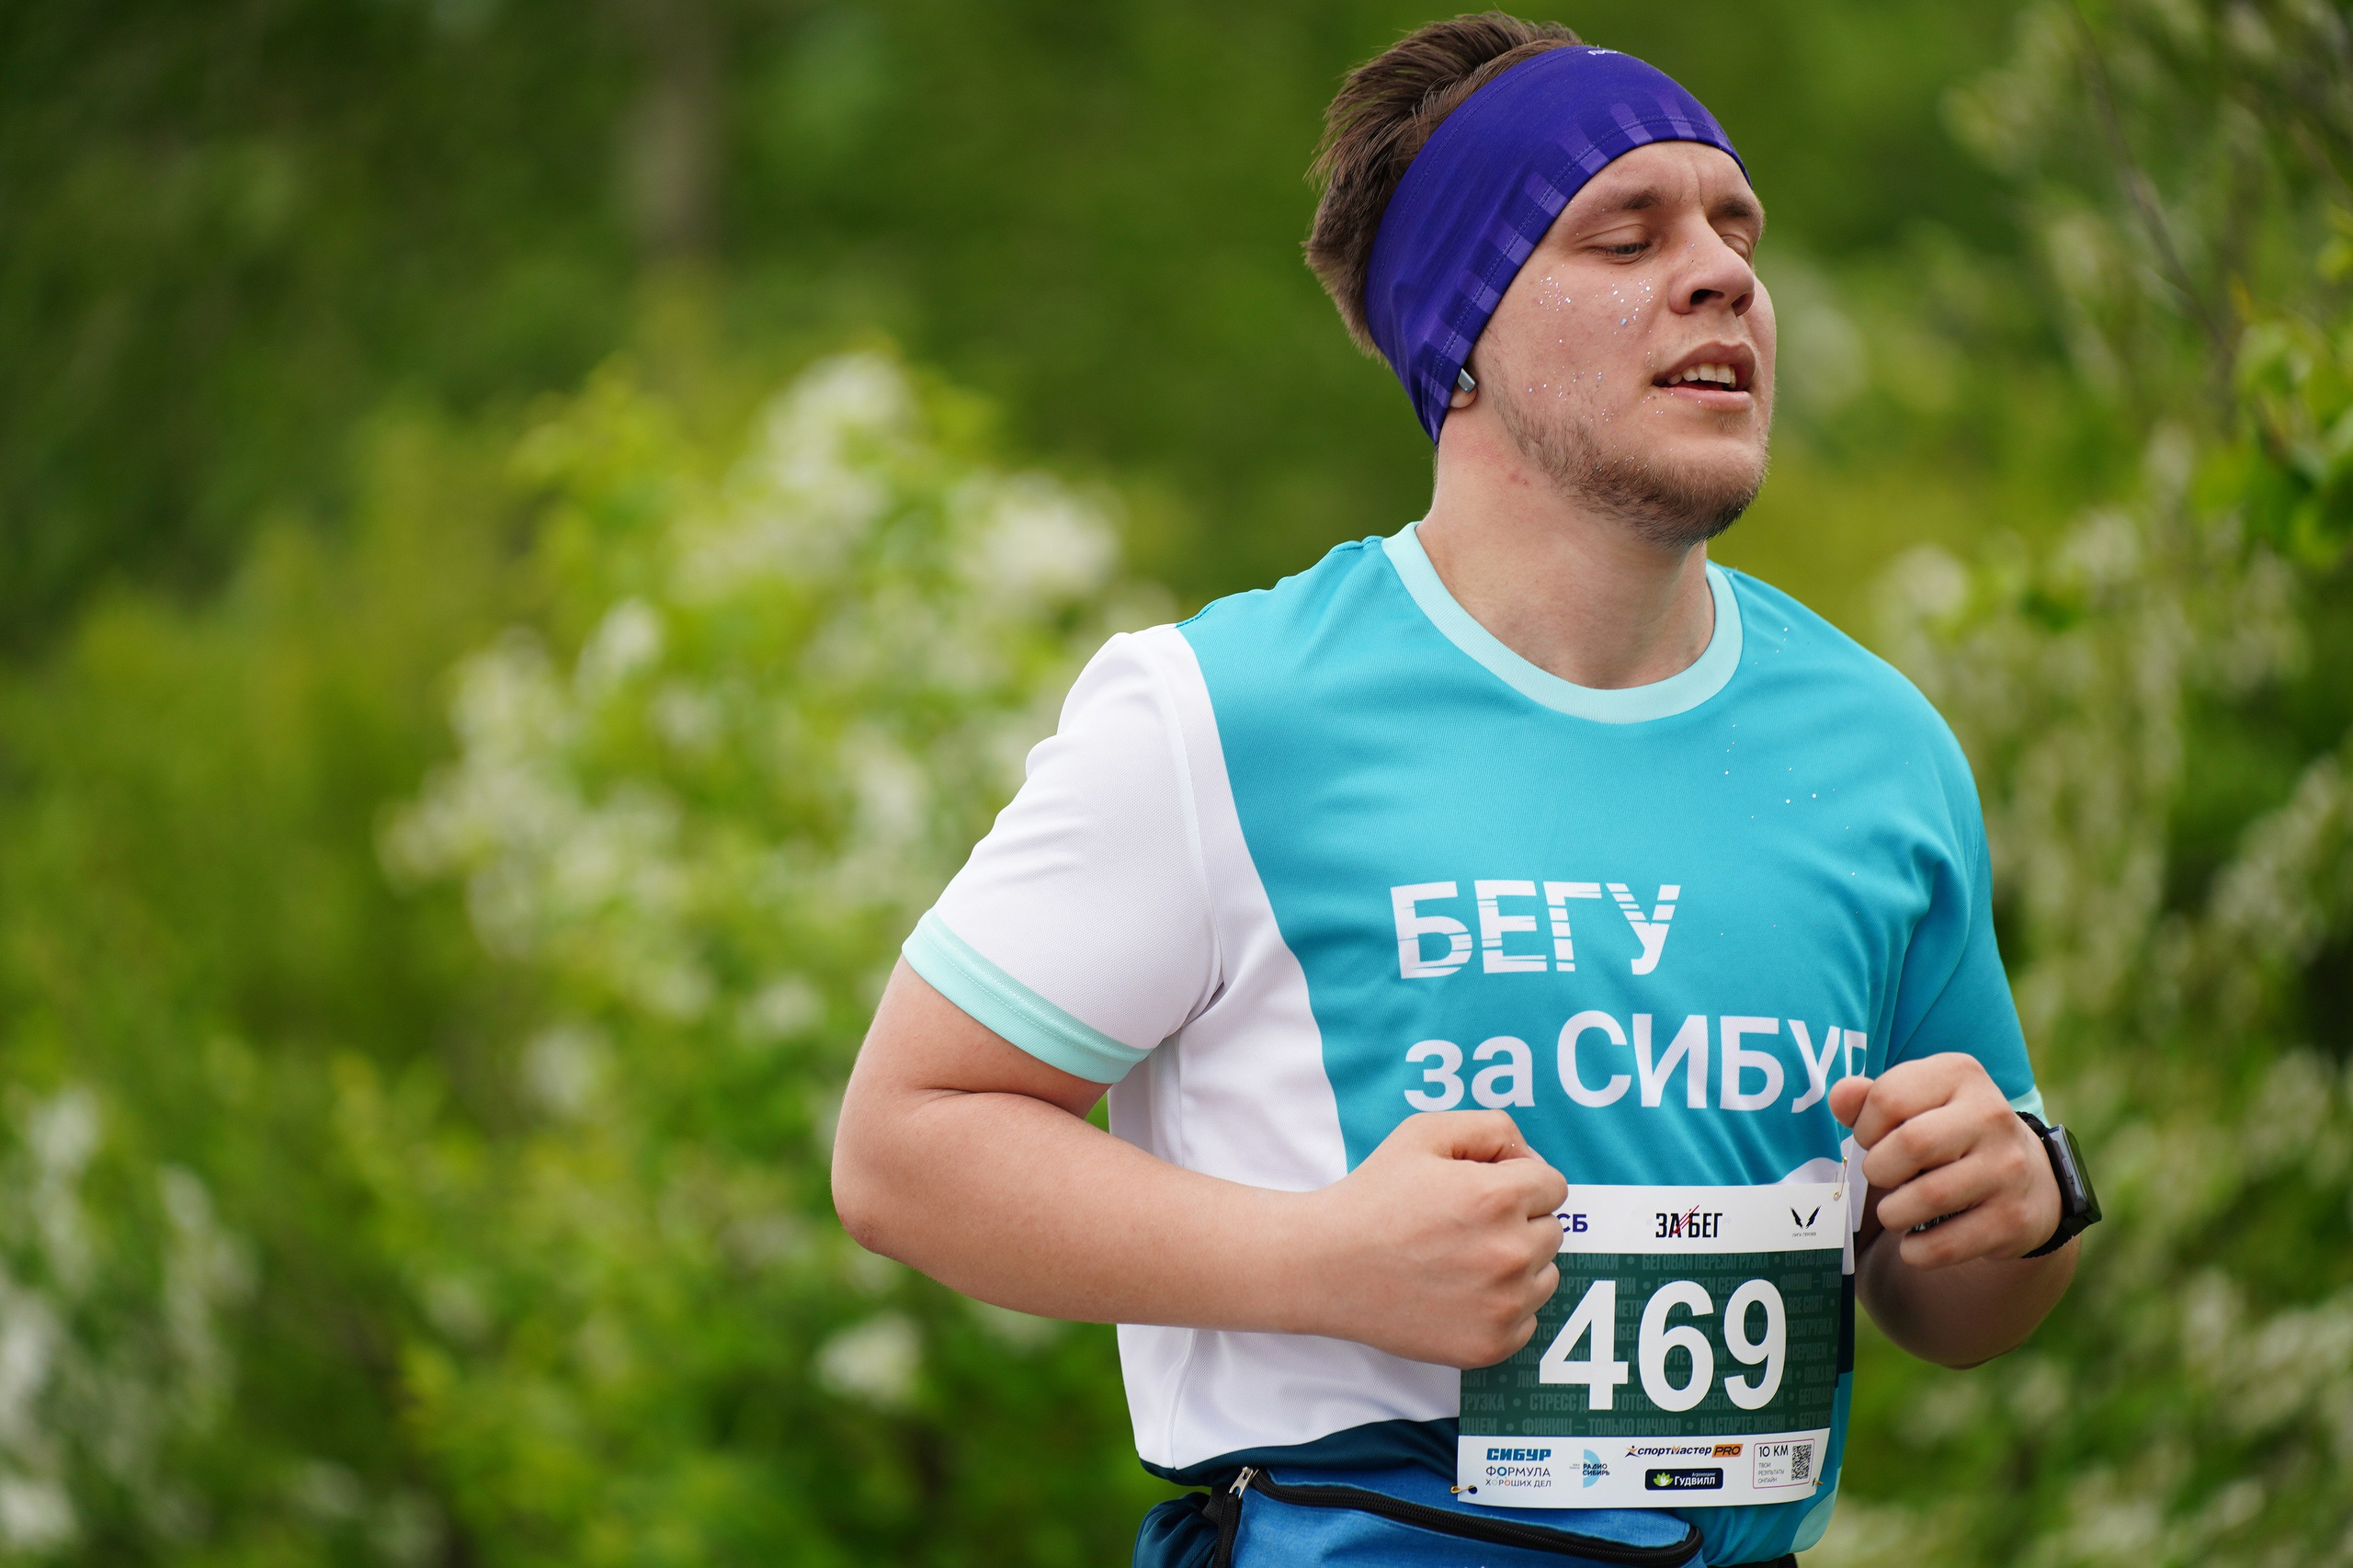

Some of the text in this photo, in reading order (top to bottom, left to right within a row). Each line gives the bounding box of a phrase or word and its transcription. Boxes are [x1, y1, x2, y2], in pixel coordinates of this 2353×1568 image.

[1391, 880, 1681, 980] БЕГУ
[1404, 1035, 1536, 1113] за
[1642, 1254, 1693, 1270] БЕГОВАЯ
[1695, 1252, 1769, 1270] ПЕРЕЗАГРУЗКА
[1540, 1278, 1787, 1412] 469
[1529, 1393, 1576, 1411] СТРЕСС
[1522, 1418, 1573, 1436] ФИНИШ
[1588, 1418, 1634, 1436] ТОЛЬКО
[1637, 1418, 1681, 1436] НАЧАЛО
[1700, 1416, 1714, 1435] НА
[1716, 1415, 1752, 1434] СТАРТЕ
[1753, 1413, 1785, 1432] ЖИЗНИ
[1486, 1449, 1552, 1461] СИБУР
[1714, 1446, 1742, 1456] PRO
[1759, 1446, 1770, 1458] 10
[1485, 1466, 1551, 1477] ФОРМУЛА
[1675, 1476, 1715, 1487] Гудвилл
